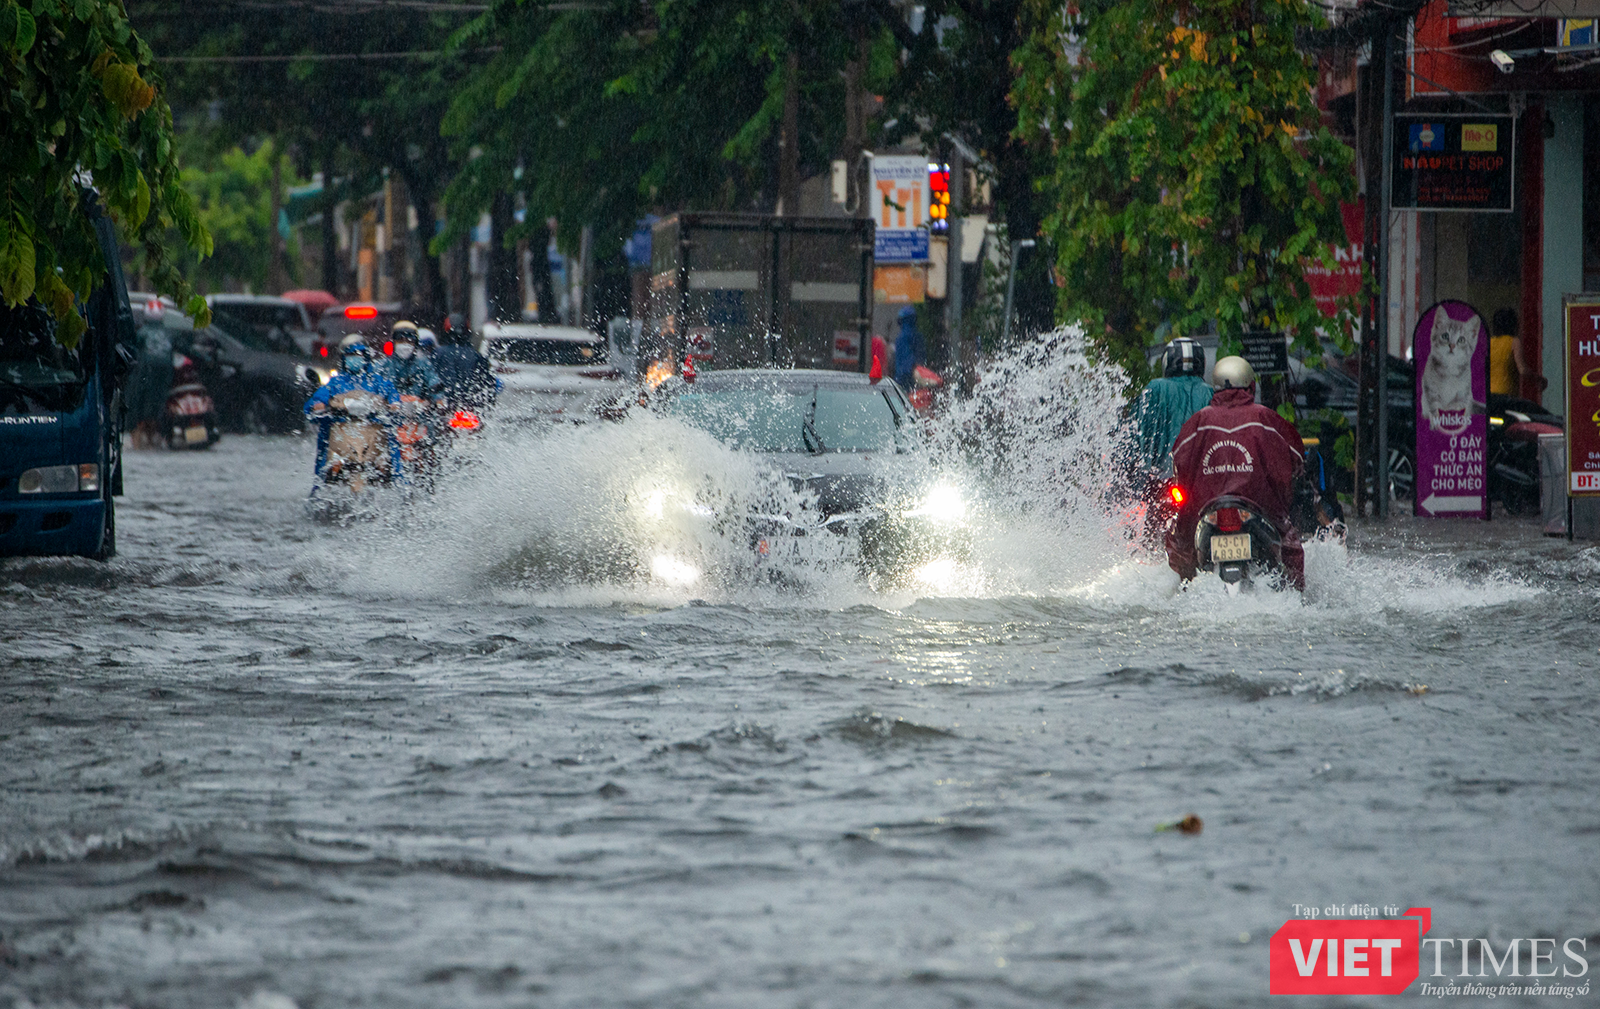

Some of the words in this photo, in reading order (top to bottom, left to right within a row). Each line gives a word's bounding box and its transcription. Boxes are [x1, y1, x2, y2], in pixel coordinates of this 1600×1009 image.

[1469, 156, 1504, 171] SHOP
[1460, 434, 1482, 448] ĐÂY
[1459, 448, 1482, 462] BÁN
[1433, 462, 1463, 476] THỨC
[1431, 478, 1454, 490] CHO
